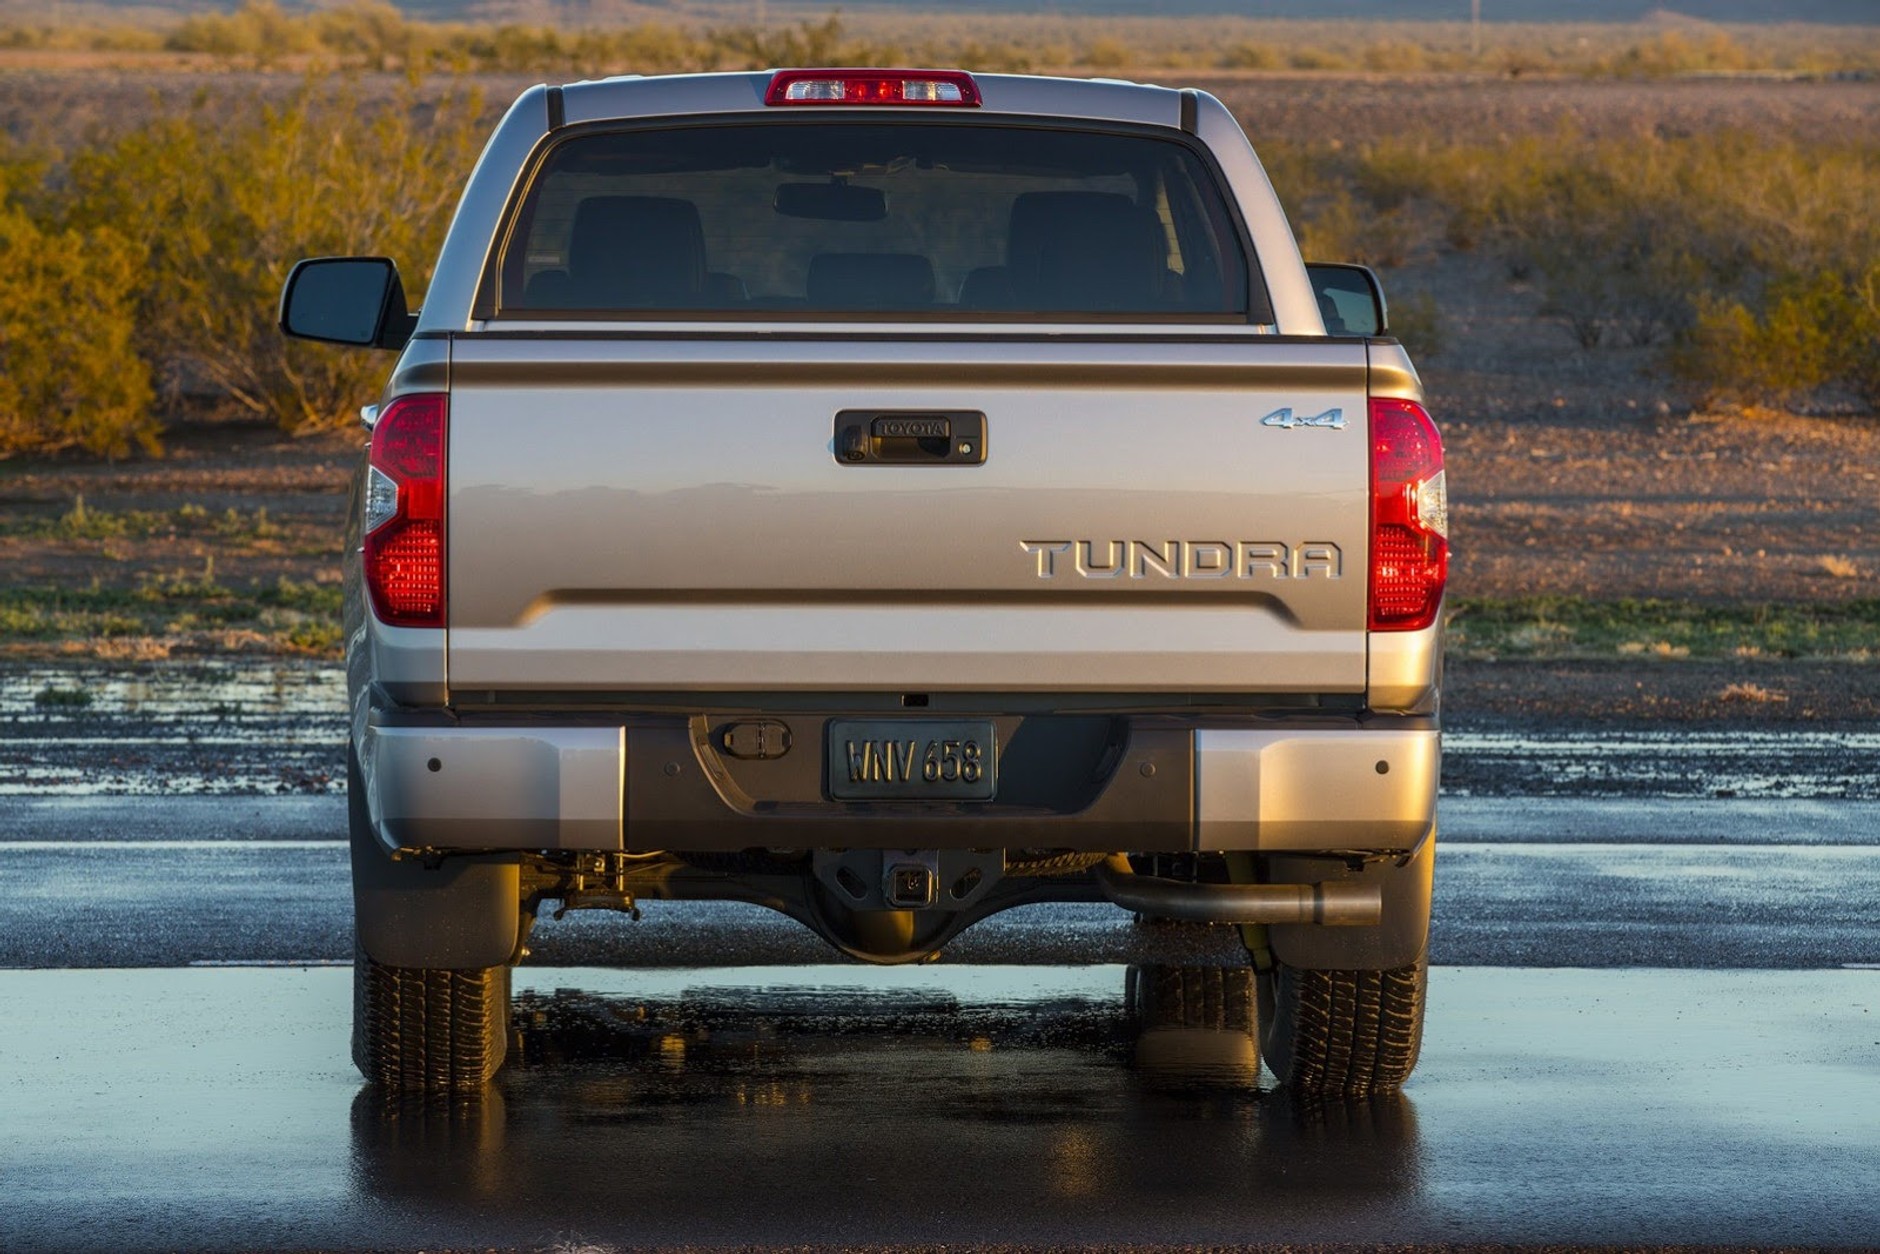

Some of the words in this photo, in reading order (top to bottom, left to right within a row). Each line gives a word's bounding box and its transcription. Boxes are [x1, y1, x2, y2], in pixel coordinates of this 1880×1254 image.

[881, 421, 943, 436] TOYOTA
[1019, 540, 1343, 579] TUNDRA
[846, 740, 915, 782] WNV
[923, 740, 983, 783] 658
